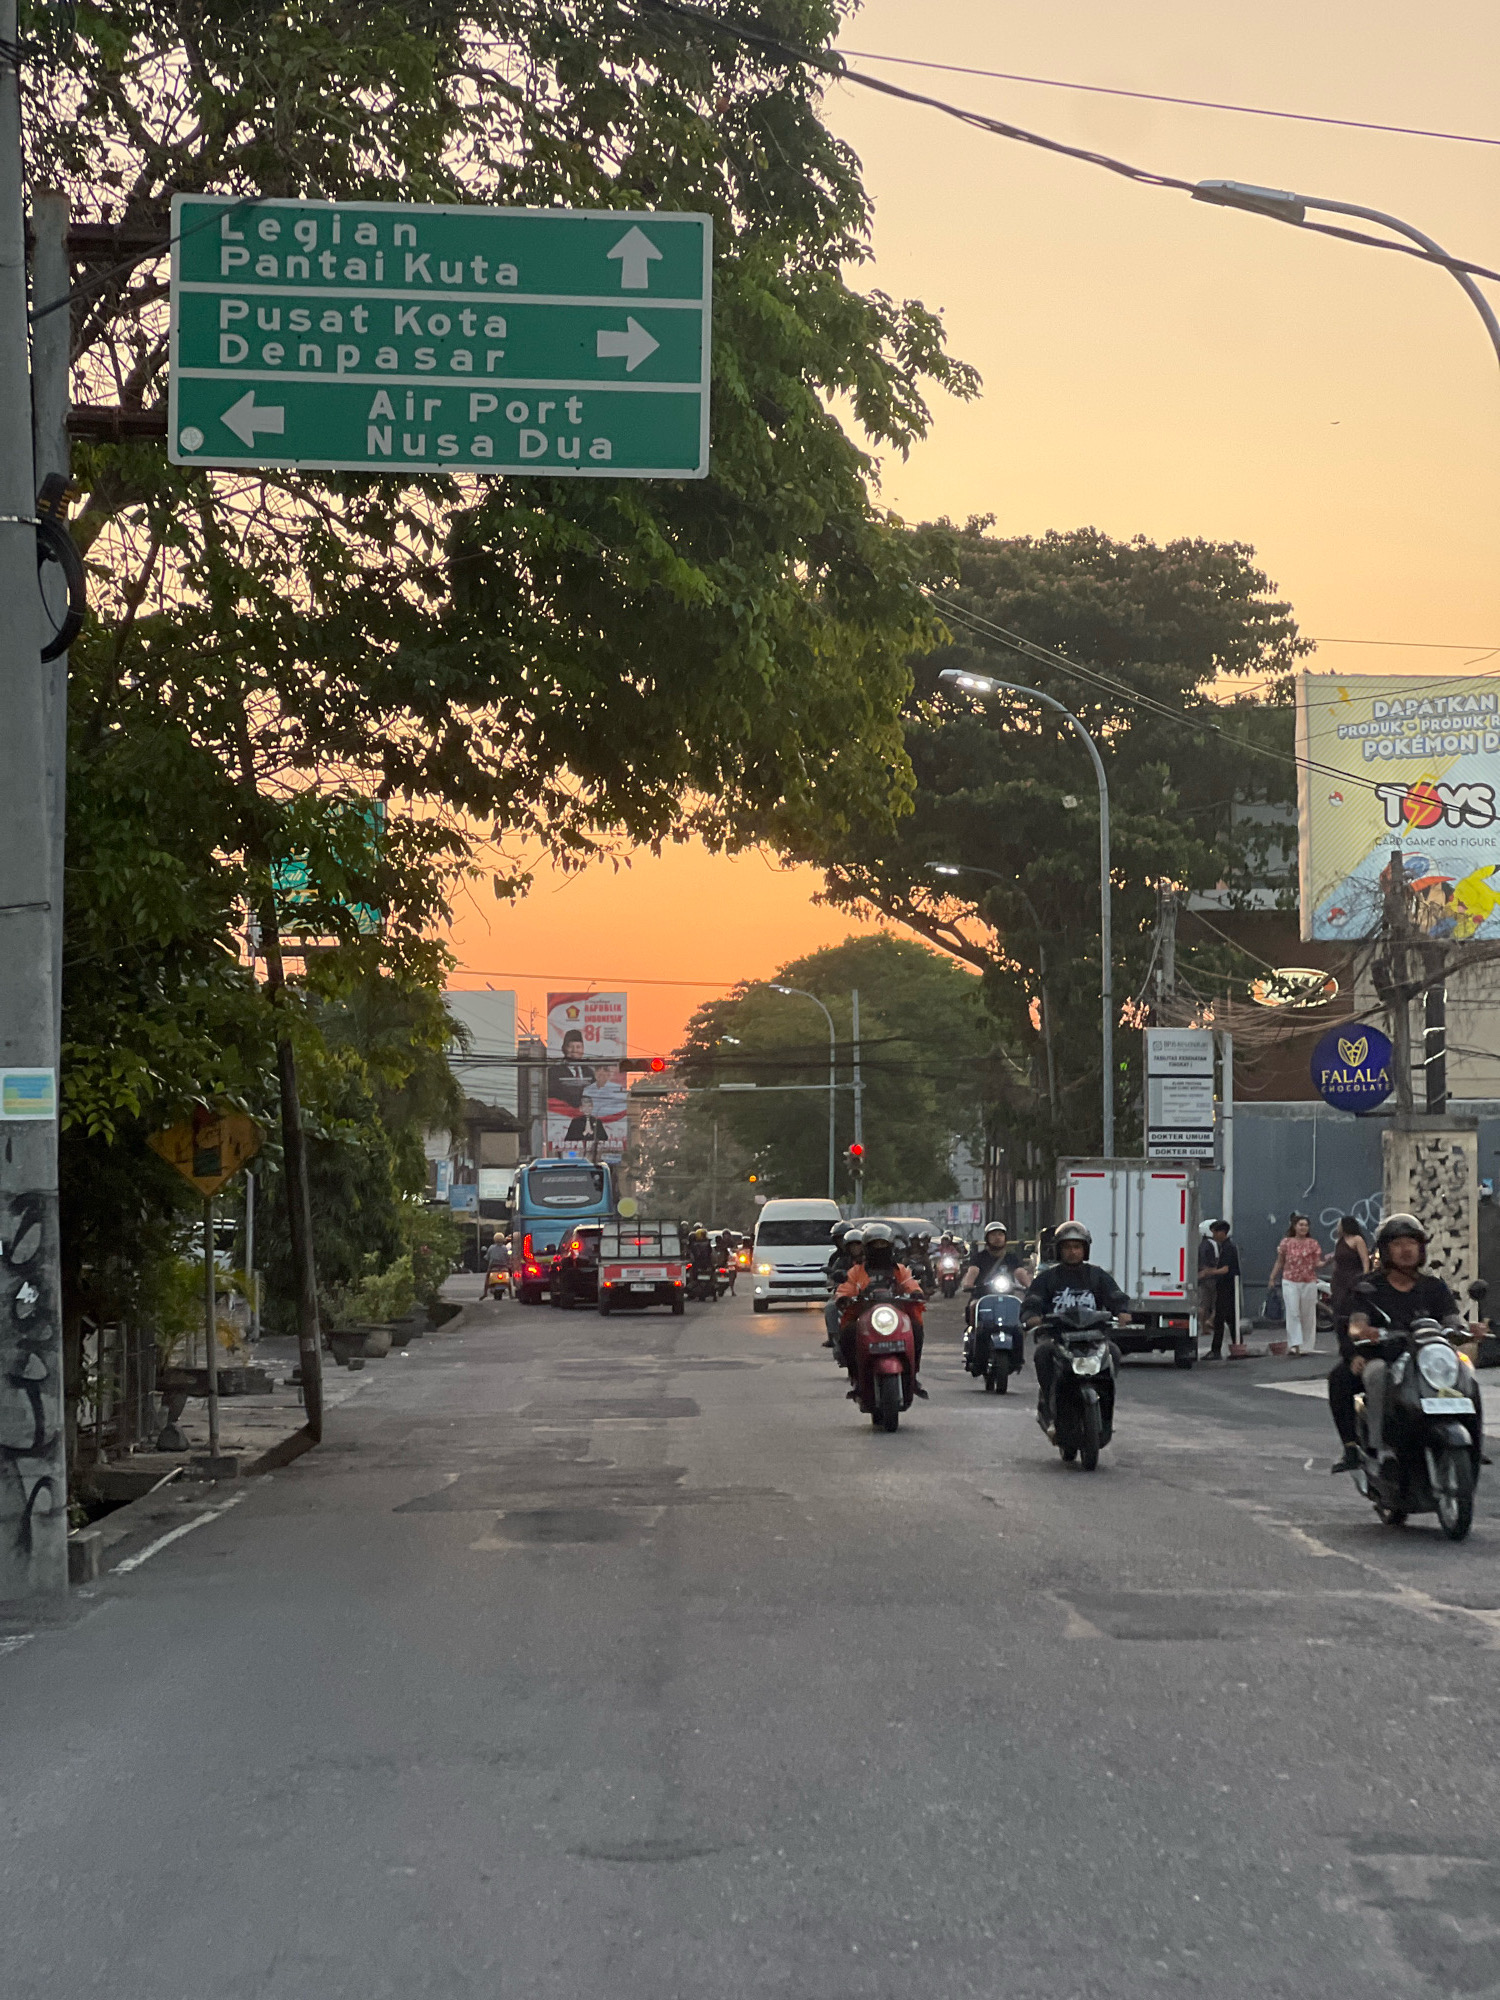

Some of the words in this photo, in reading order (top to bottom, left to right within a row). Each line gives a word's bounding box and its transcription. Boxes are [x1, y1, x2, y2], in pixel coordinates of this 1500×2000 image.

[221, 212, 417, 252] Legian
[221, 246, 384, 281] Pantai
[405, 253, 518, 287] Kuta
[221, 299, 369, 334] Pusat
[394, 305, 508, 338] Kota
[219, 333, 505, 374] Denpasar
[368, 390, 443, 422] Air
[469, 392, 584, 425] Port
[367, 425, 494, 459] Nusa
[519, 430, 612, 460] Dua
[1374, 694, 1495, 718] DAPATKAN
[1338, 721, 1402, 737] PRODUK
[1421, 715, 1485, 731] PRODUK
[1364, 733, 1475, 757] POKÉMON
[1375, 782, 1496, 829] TOYS
[1375, 837, 1402, 847] CARD
[1405, 837, 1436, 847] GAME
[1438, 836, 1458, 847] and
[1460, 837, 1496, 847] FIGURE
[1321, 1068, 1389, 1084] FALALA
[1321, 1083, 1391, 1093] CHOCOLATE
